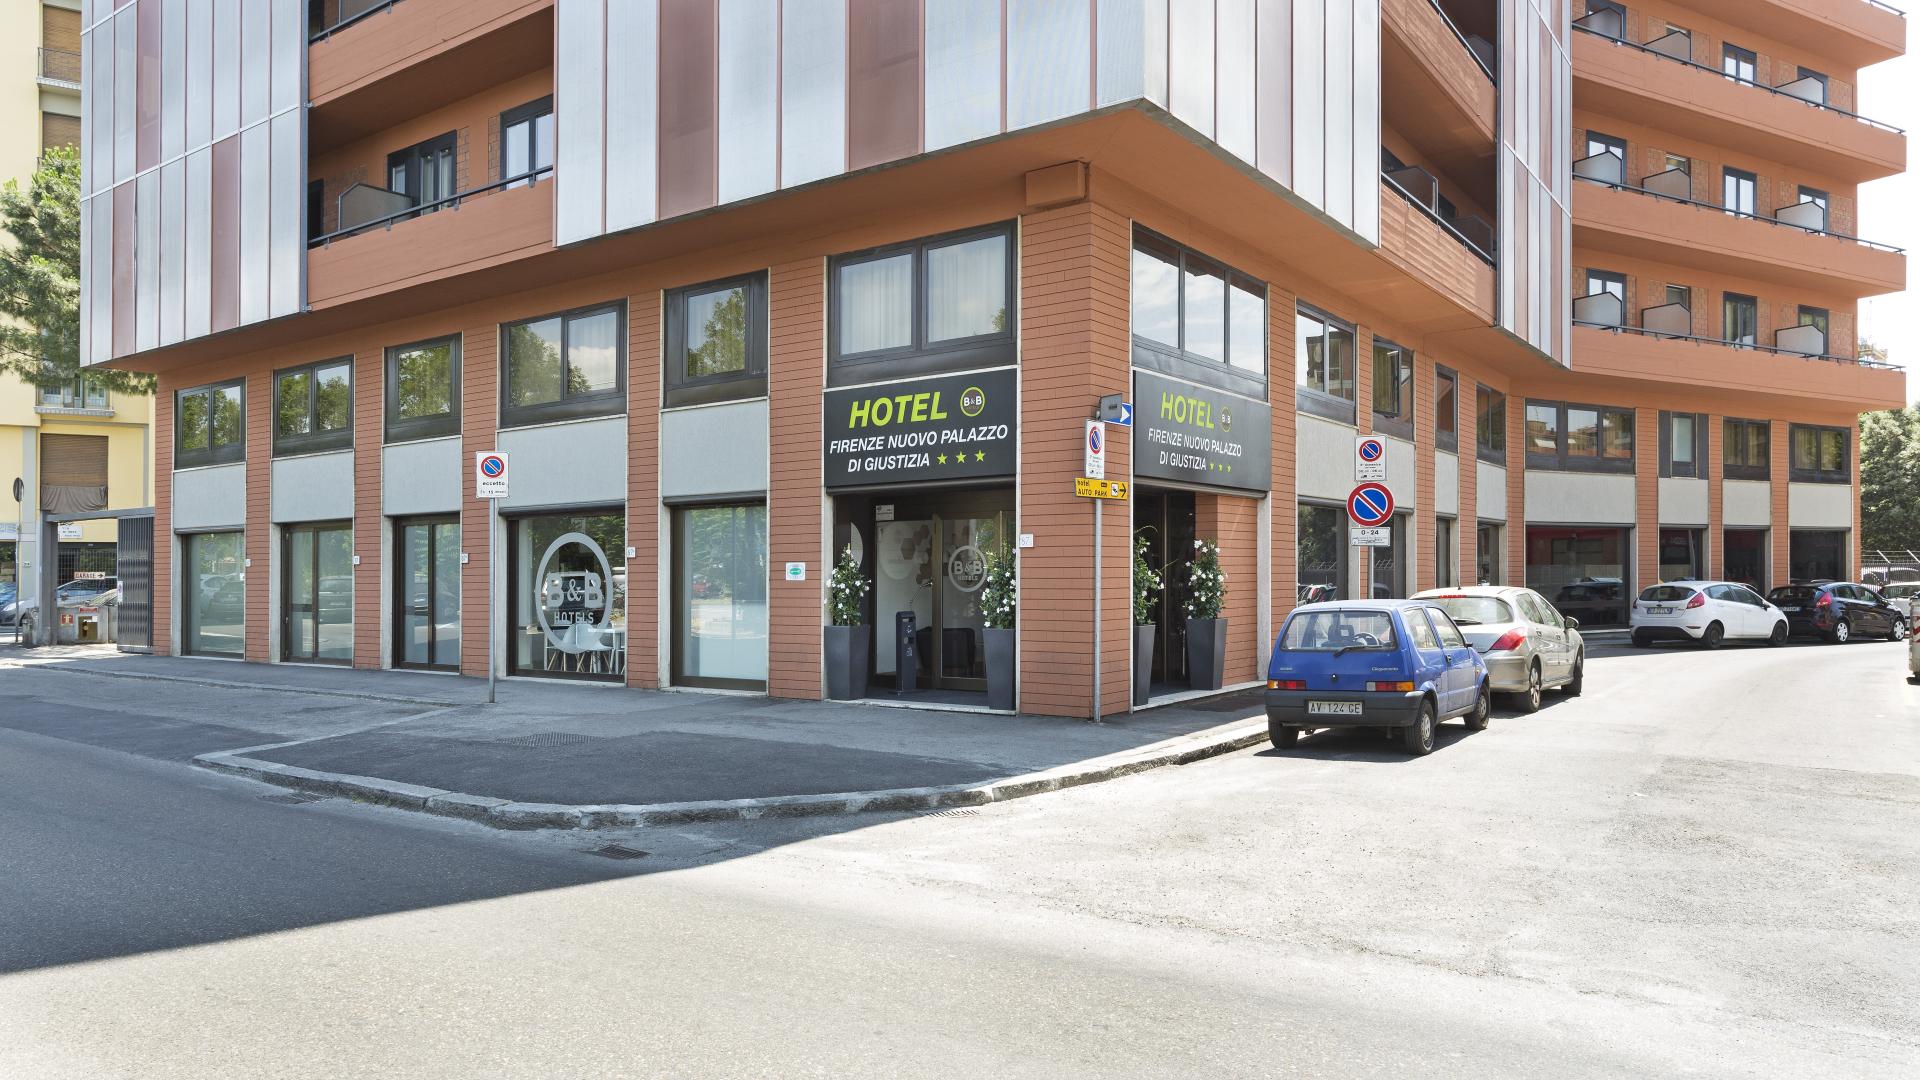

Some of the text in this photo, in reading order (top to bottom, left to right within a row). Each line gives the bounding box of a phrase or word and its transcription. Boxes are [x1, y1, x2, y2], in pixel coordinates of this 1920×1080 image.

[849, 391, 947, 429] HOTEL
[963, 395, 983, 407] B&B
[1160, 391, 1215, 429] HOTEL
[829, 424, 1009, 454] FIRENZE NUOVO PALAZZO
[1148, 427, 1242, 457] FIRENZE NUOVO PALAZZO
[847, 453, 930, 472] DI GIUSTIZIA
[1159, 451, 1207, 470] DI GIUSTIZIA
[1077, 488, 1108, 497] AUTO PARK
[953, 560, 983, 575] B&B
[546, 571, 604, 609] B&B
[554, 611, 594, 624] HOTELS
[1310, 703, 1361, 713] AV 124 GE
